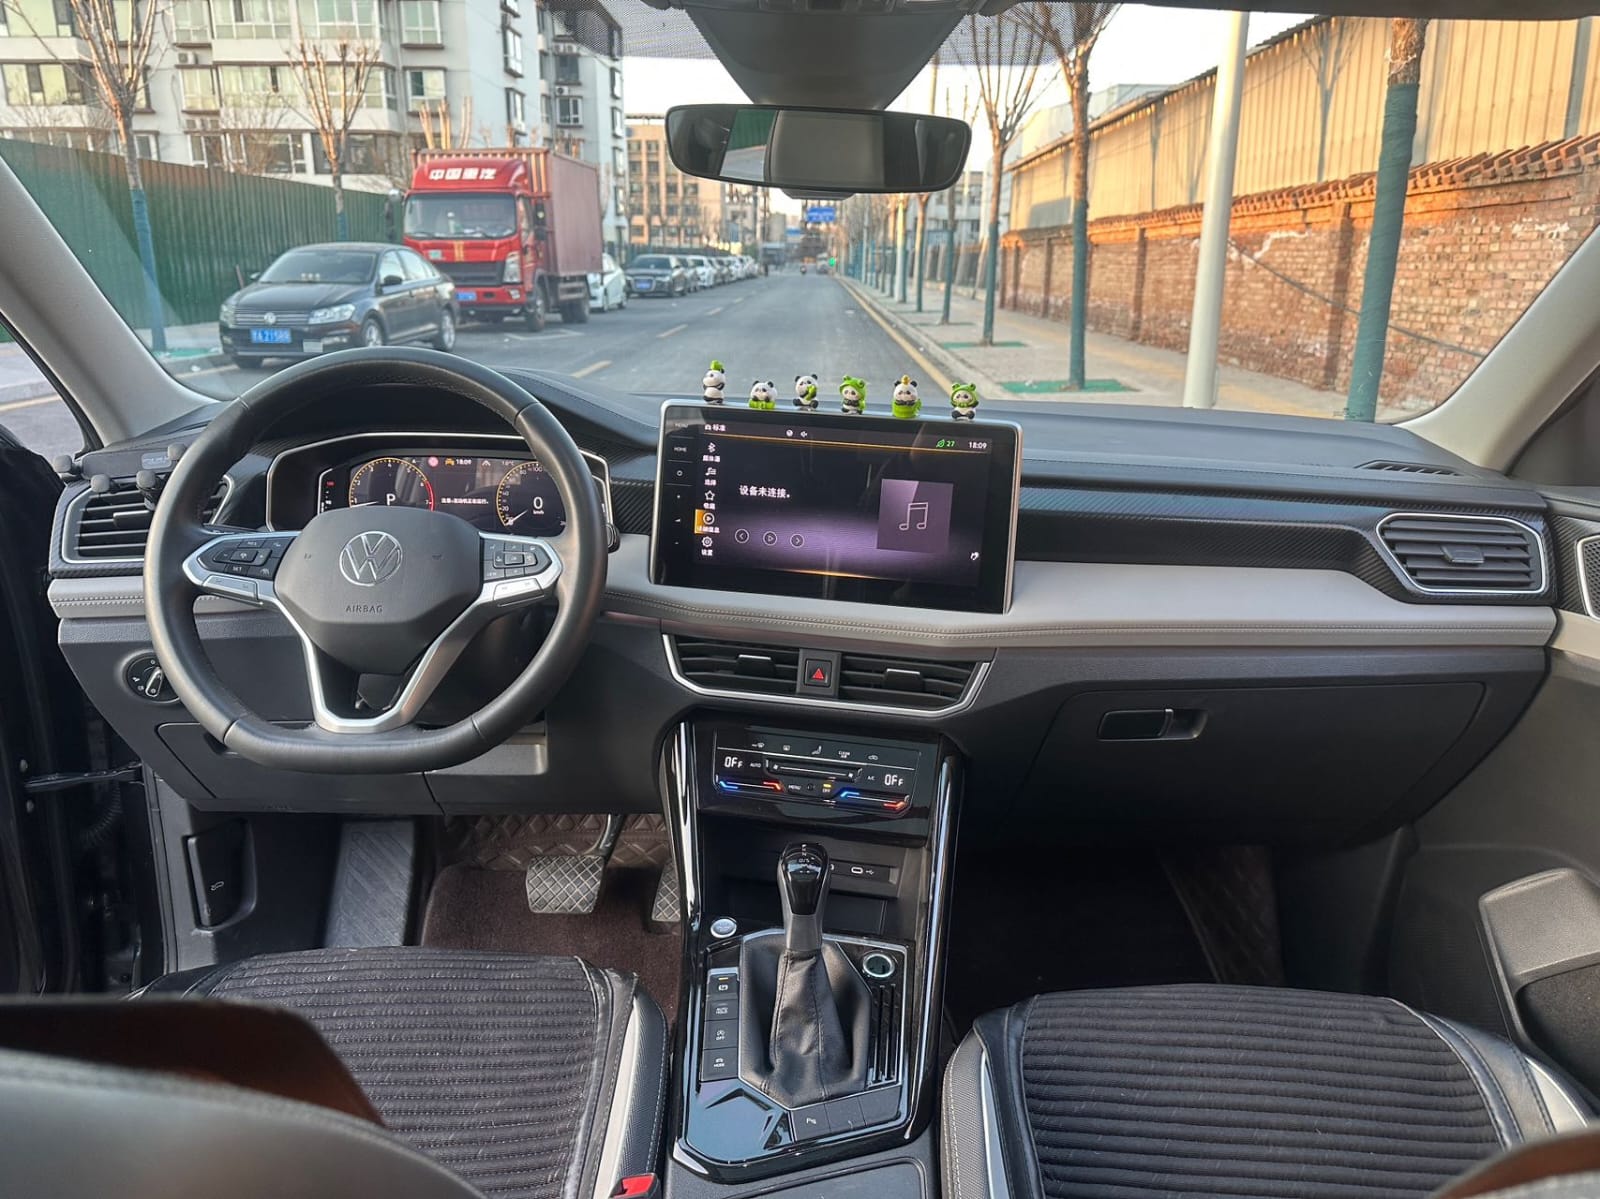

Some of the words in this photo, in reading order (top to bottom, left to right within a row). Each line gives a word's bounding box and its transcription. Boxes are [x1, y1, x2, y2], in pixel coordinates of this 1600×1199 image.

[429, 168, 497, 180] 中国重汽
[385, 493, 397, 506] P
[533, 497, 543, 510] 0
[345, 605, 383, 613] AIRBAG
